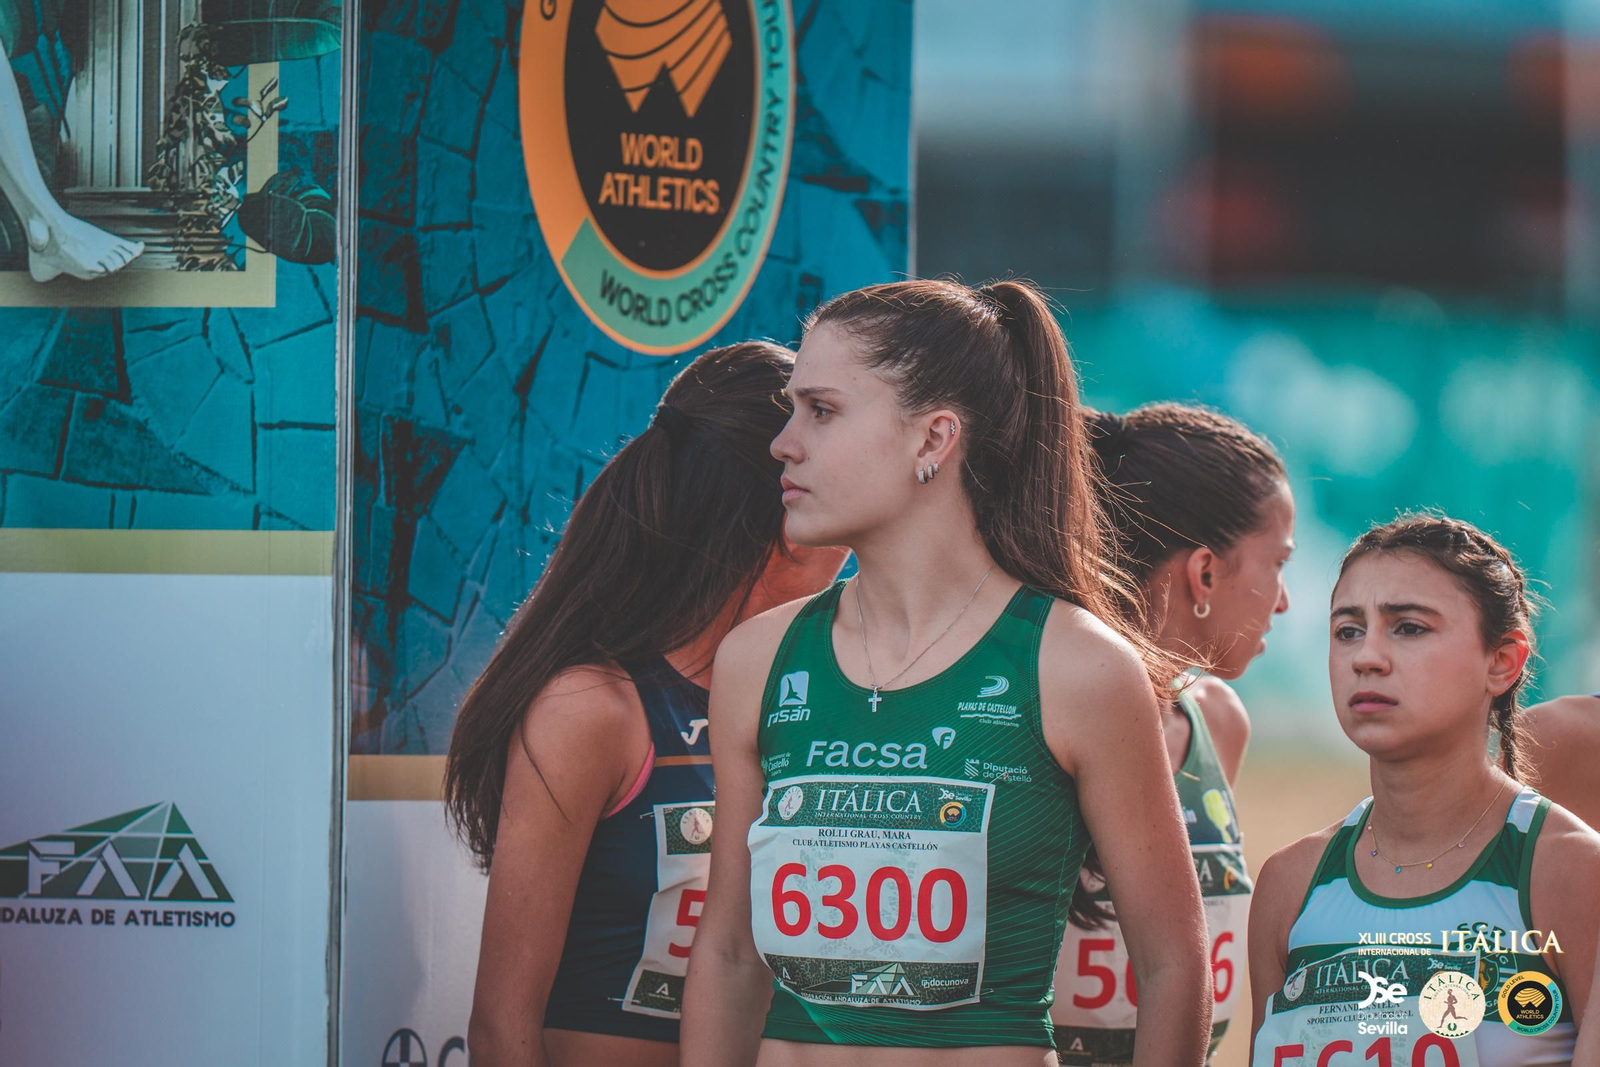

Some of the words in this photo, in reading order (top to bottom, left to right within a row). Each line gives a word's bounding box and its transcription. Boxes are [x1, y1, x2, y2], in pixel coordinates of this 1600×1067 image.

[620, 132, 704, 171] WORLD
[598, 172, 721, 215] ATHLETICS
[599, 268, 673, 327] WORLD
[674, 250, 738, 323] CROSS
[735, 86, 784, 256] COUNTRY
[957, 701, 978, 711] PLAYAS
[978, 702, 987, 712] DE
[983, 762, 1028, 775] Diputació
[983, 771, 995, 779] de
[815, 784, 922, 813] ITÁLICA
[815, 811, 867, 819] INTERNATIONAL
[818, 828, 848, 838] ROLLI
[850, 829, 881, 840] GRAU,
[882, 831, 911, 840] MARA
[792, 839, 811, 847] CLUB
[811, 840, 858, 848] ATLETISMO
[860, 841, 890, 849] PLAYAS
[892, 841, 938, 850] CASTELLÓN
[27, 839, 219, 899] FAA
[771, 862, 968, 943] 6300
[0, 906, 83, 926] DALUZA
[91, 908, 116, 926] DE
[124, 909, 236, 928] ATLETISMO
[930, 978, 969, 987] docunova
[834, 996, 868, 1004] ANDALUZA
[1306, 1013, 1343, 1025] SPORTING
